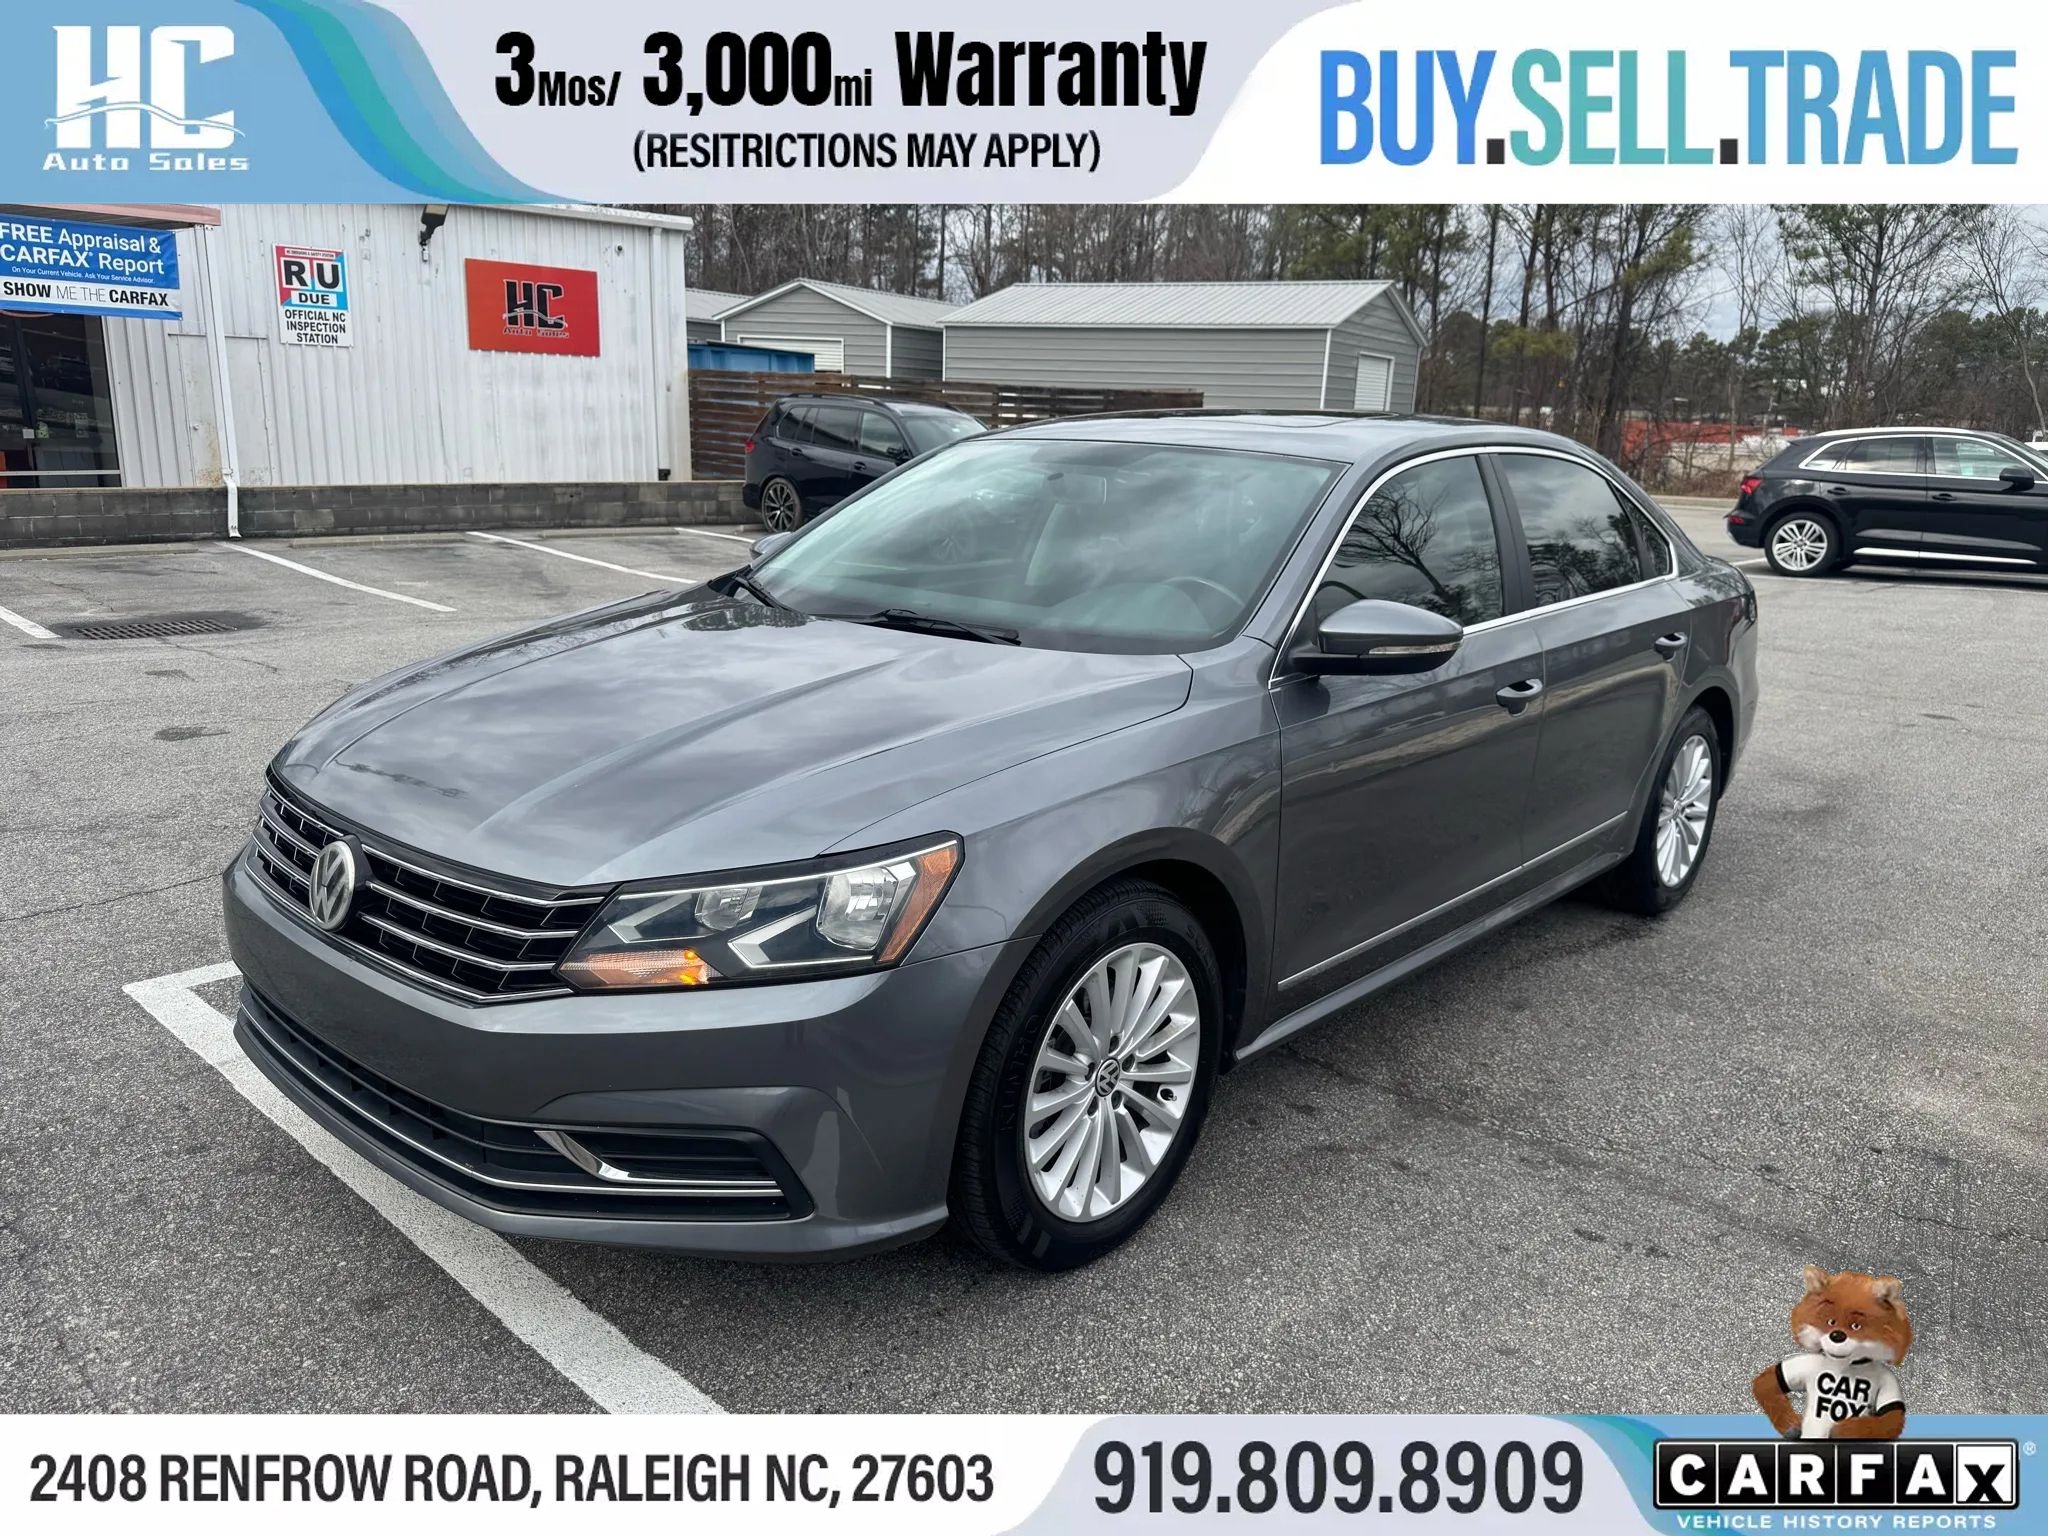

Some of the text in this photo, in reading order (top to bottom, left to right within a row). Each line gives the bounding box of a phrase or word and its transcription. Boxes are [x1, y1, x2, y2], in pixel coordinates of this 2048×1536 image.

[0, 222, 161, 254] FREE Appraisal &
[98, 253, 164, 276] Report
[12, 265, 21, 273] On
[21, 266, 36, 274] Your
[37, 268, 60, 277] Current
[60, 269, 83, 278] Vehicle.
[84, 271, 96, 280] Ask
[96, 273, 110, 281] Your
[111, 274, 132, 282] Service
[3, 281, 169, 306] SHOW ME THE CARFAX
[298, 292, 330, 305] DUE
[503, 279, 564, 330] HC
[284, 308, 346, 323] OFFICIAL NC
[286, 320, 346, 334] INSPECTION
[296, 332, 338, 344] STATION
